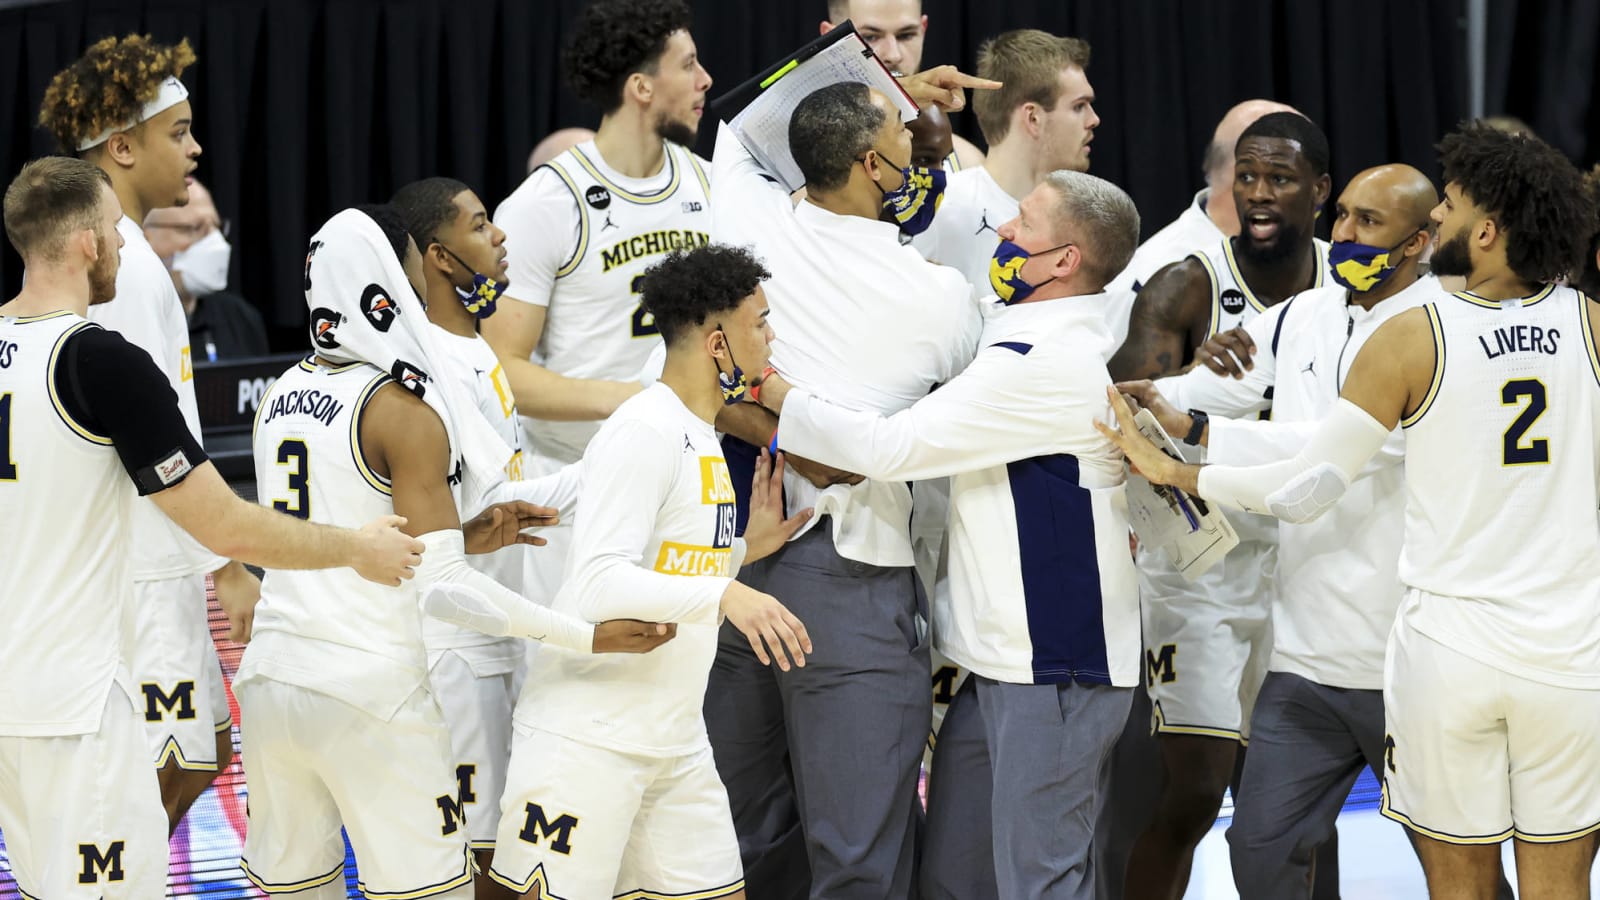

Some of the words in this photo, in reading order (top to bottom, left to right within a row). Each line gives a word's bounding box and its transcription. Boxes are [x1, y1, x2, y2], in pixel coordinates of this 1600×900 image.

[1223, 297, 1243, 306] BLM
[1478, 325, 1561, 359] LIVERS
[237, 376, 276, 414] PO
[264, 389, 344, 427] JACKSON
[1500, 376, 1551, 467] 2
[271, 437, 311, 521] 3
[718, 505, 732, 546] US
[1146, 643, 1177, 688] M
[140, 680, 197, 722] M
[435, 794, 466, 837] M
[518, 801, 580, 856] M
[77, 840, 126, 885] M
